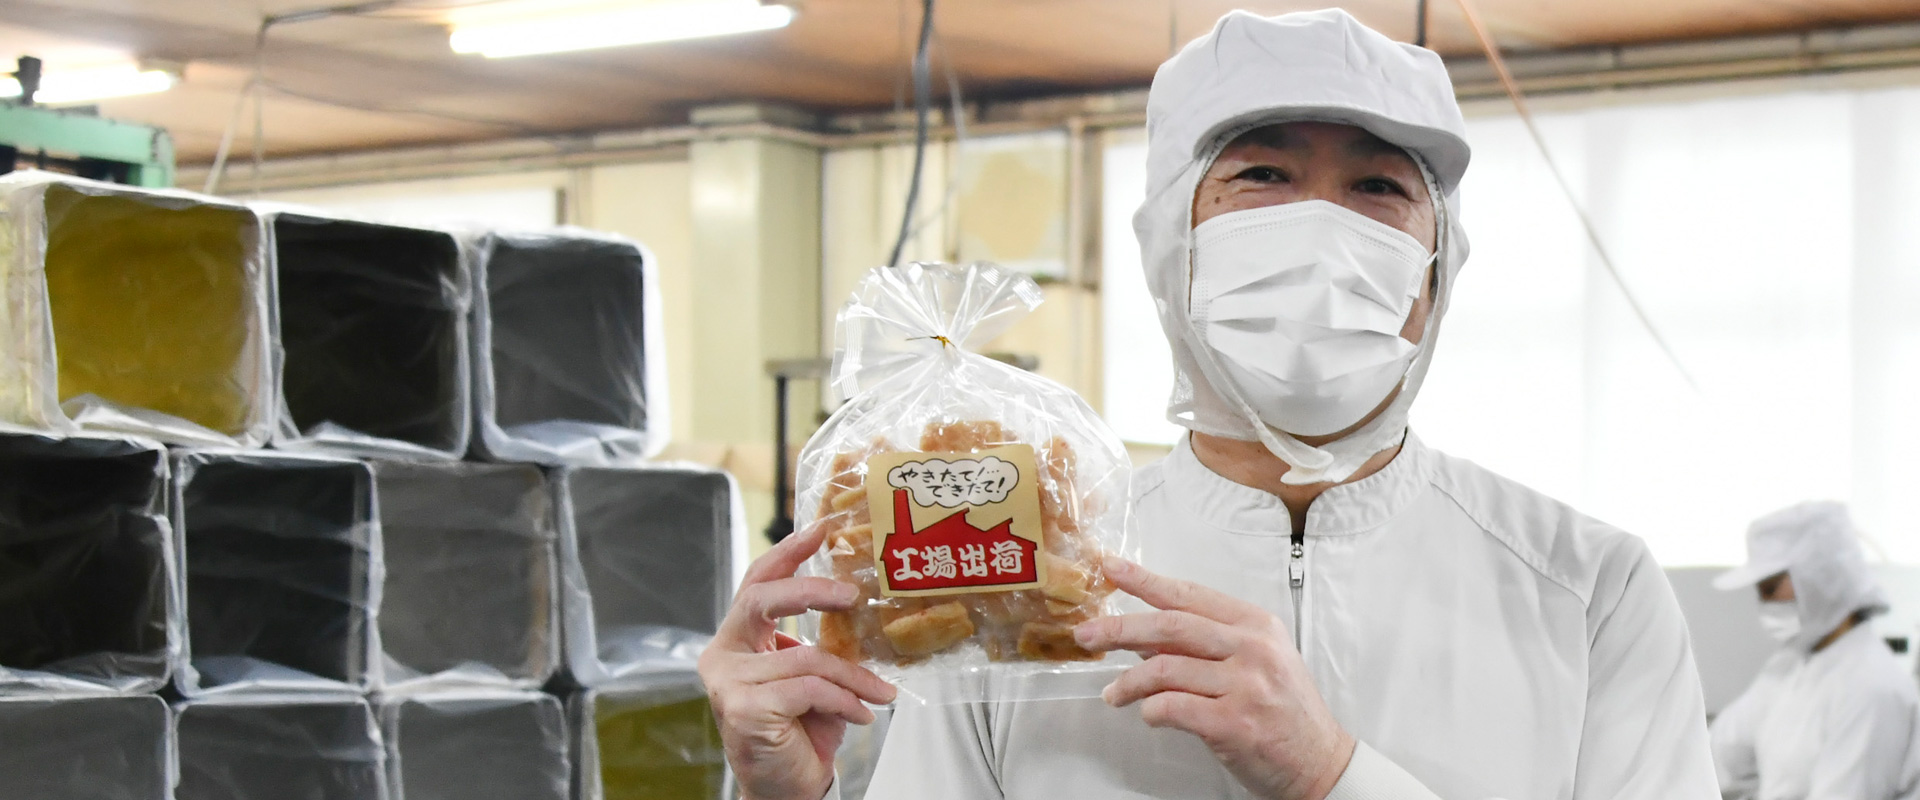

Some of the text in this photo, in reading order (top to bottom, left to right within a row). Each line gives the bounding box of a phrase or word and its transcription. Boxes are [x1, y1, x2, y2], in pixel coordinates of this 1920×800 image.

[926, 477, 1005, 498] できたて!
[893, 540, 1024, 581] 工場出荷
